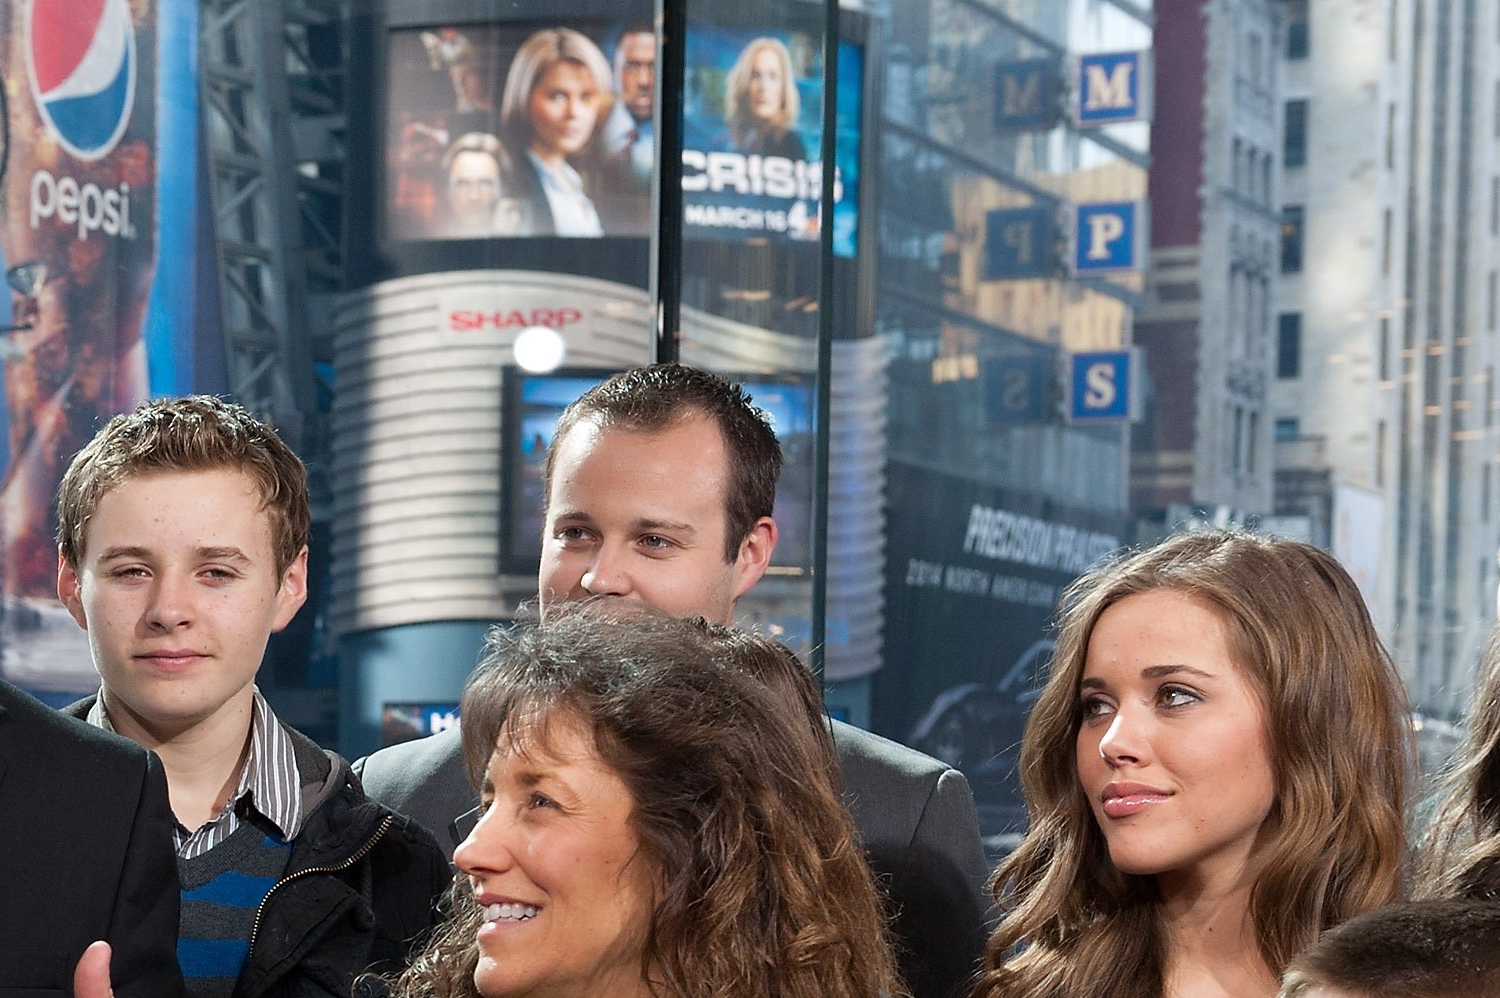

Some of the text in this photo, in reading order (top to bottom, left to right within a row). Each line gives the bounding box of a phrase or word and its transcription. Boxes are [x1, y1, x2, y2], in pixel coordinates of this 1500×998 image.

[1084, 63, 1133, 112] M
[681, 149, 844, 203] CRISIS
[30, 169, 131, 241] pepsi
[684, 204, 764, 231] MARCH
[449, 307, 583, 333] SHARP
